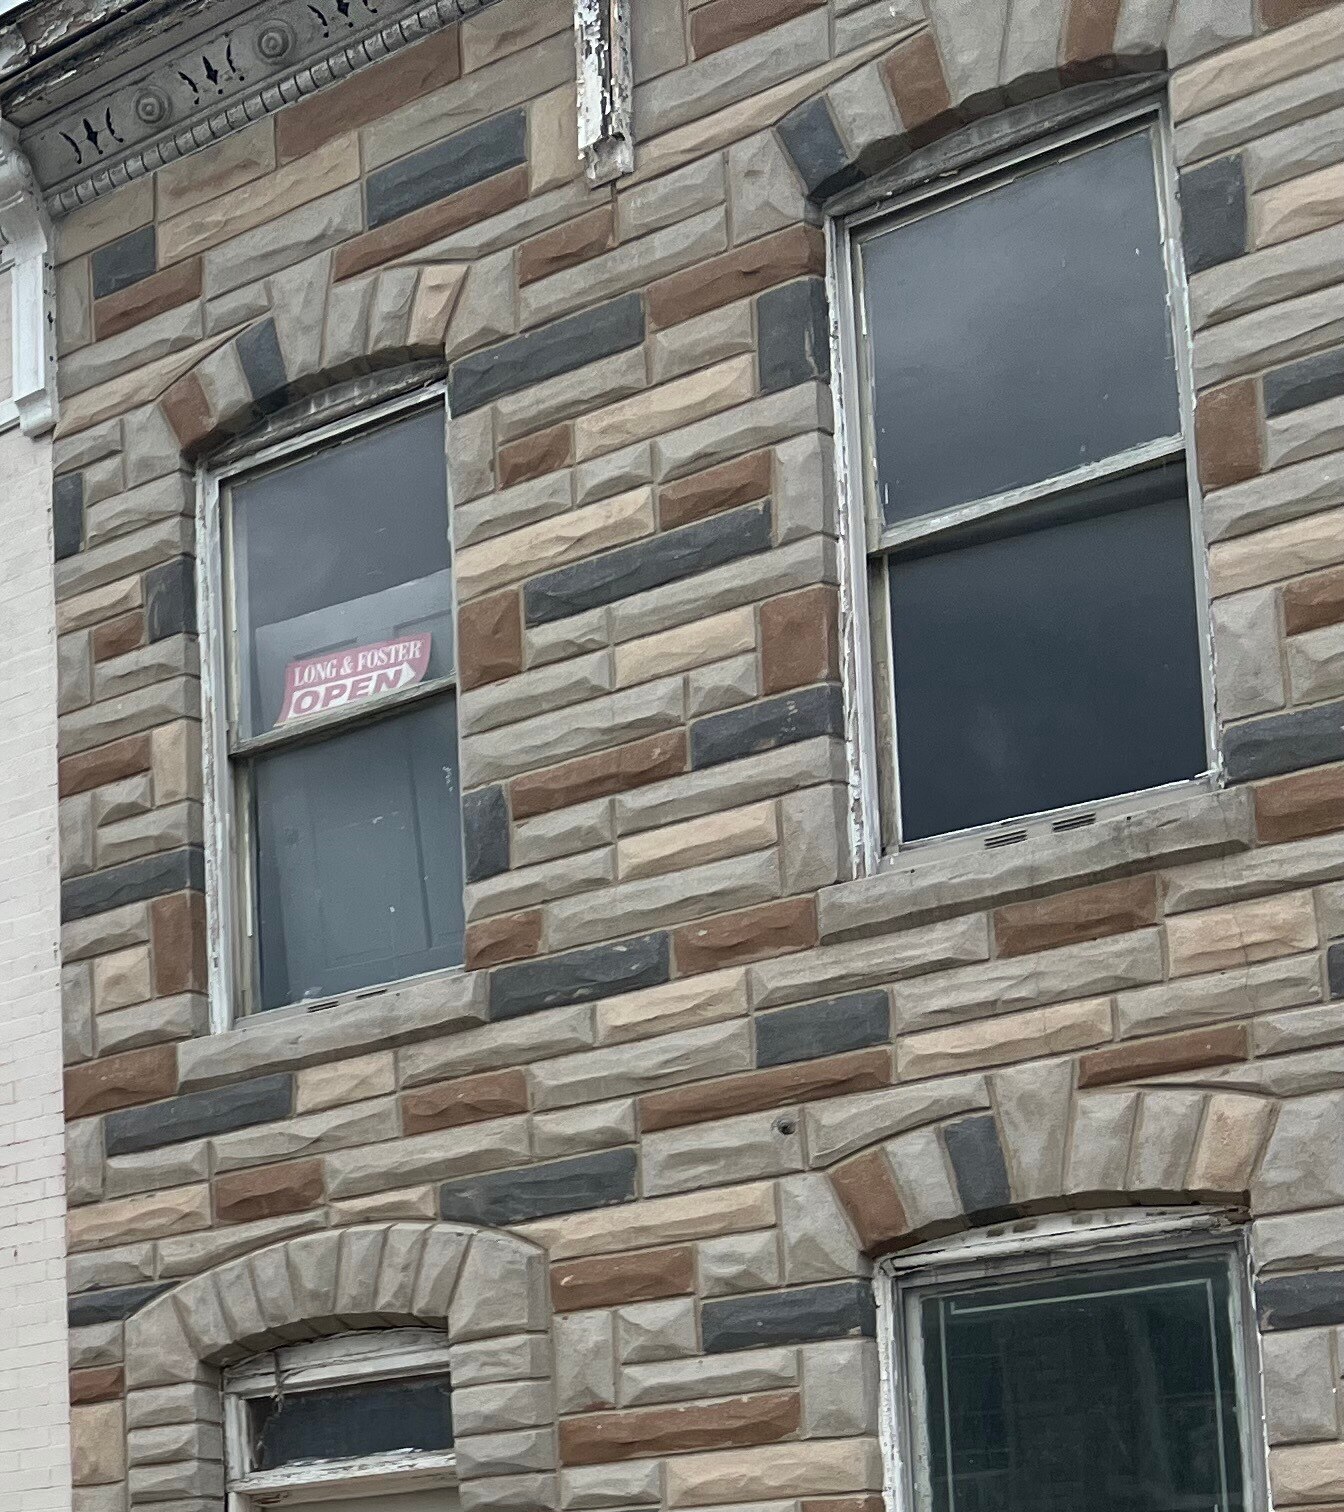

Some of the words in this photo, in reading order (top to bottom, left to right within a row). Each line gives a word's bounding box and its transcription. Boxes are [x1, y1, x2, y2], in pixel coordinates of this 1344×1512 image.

[294, 658, 337, 687] LONG
[340, 656, 354, 679] &
[358, 640, 424, 672] FOSTER
[292, 667, 404, 715] OPEN
